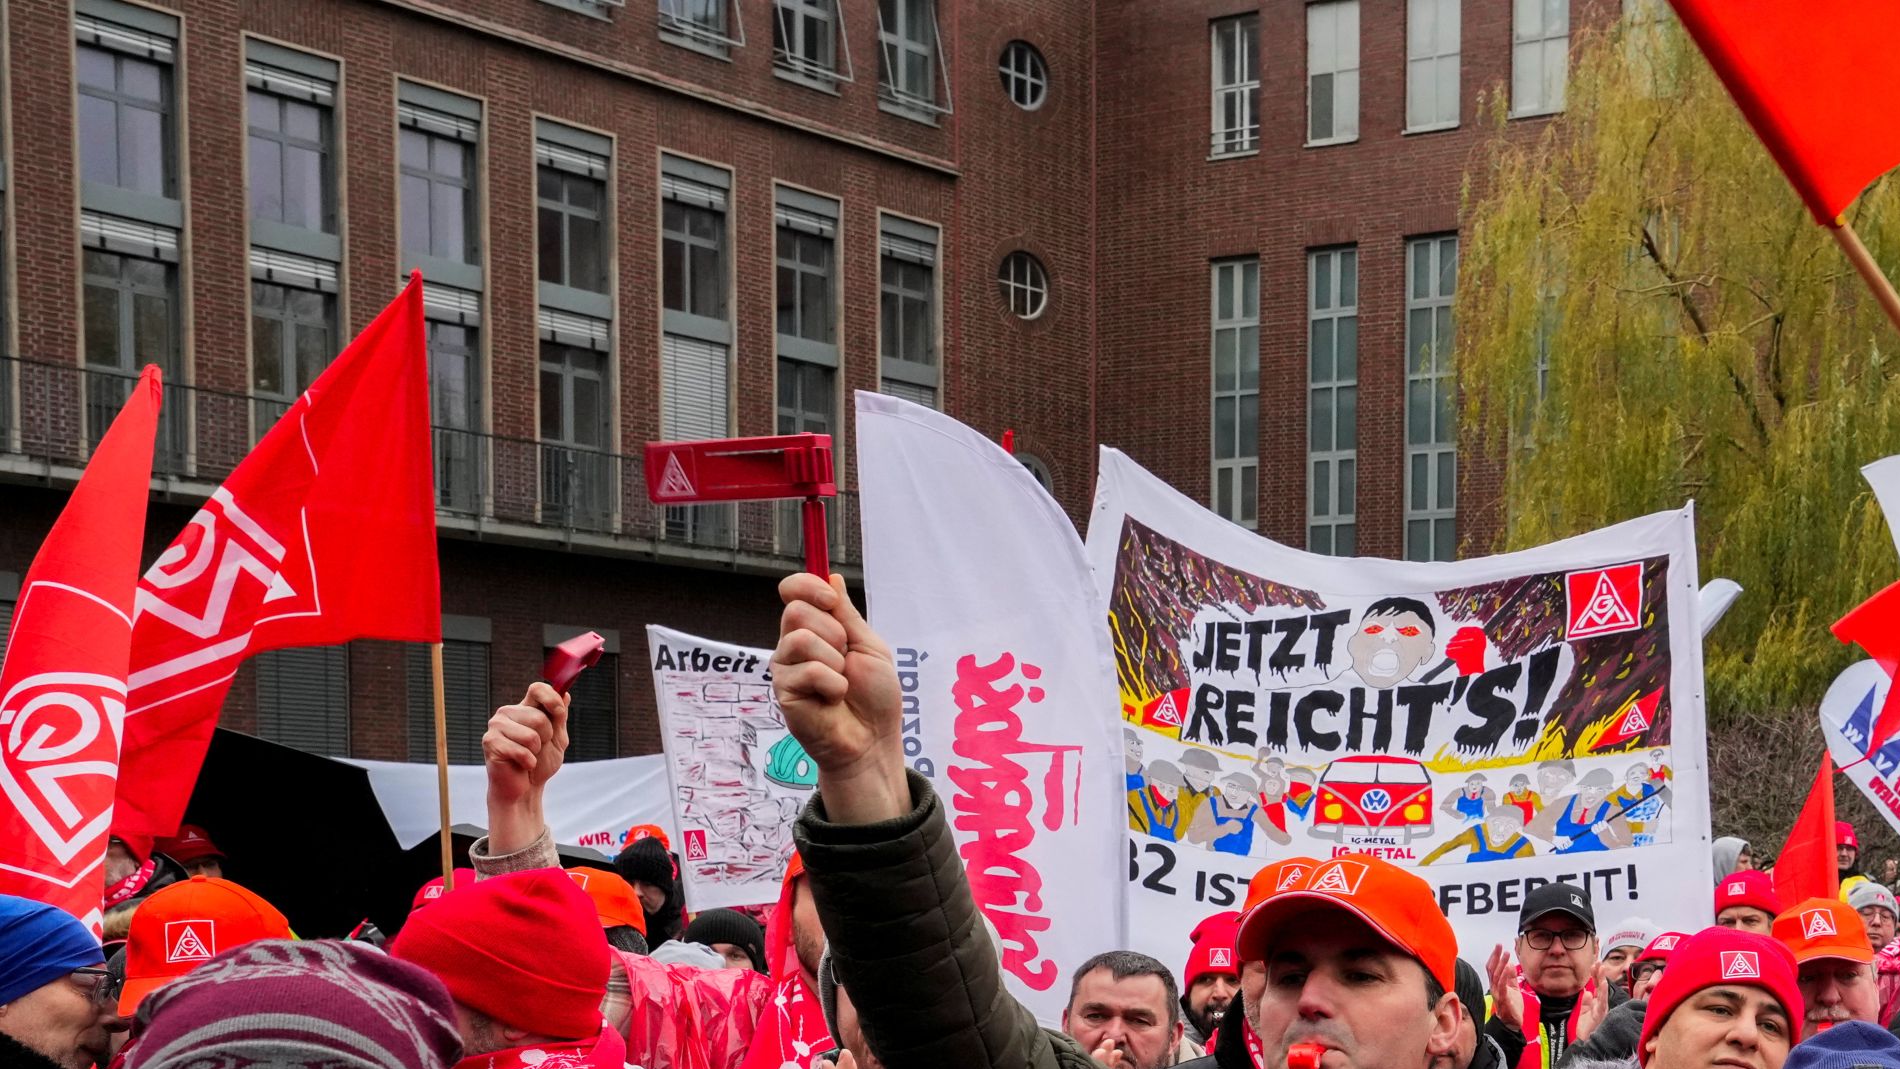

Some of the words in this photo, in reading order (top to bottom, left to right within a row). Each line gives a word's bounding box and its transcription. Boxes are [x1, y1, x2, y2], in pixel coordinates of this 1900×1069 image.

[655, 644, 760, 673] Arbeit
[1192, 609, 1350, 684] JETZT
[1185, 644, 1563, 755] REICHT'S!
[579, 831, 615, 847] WIR,
